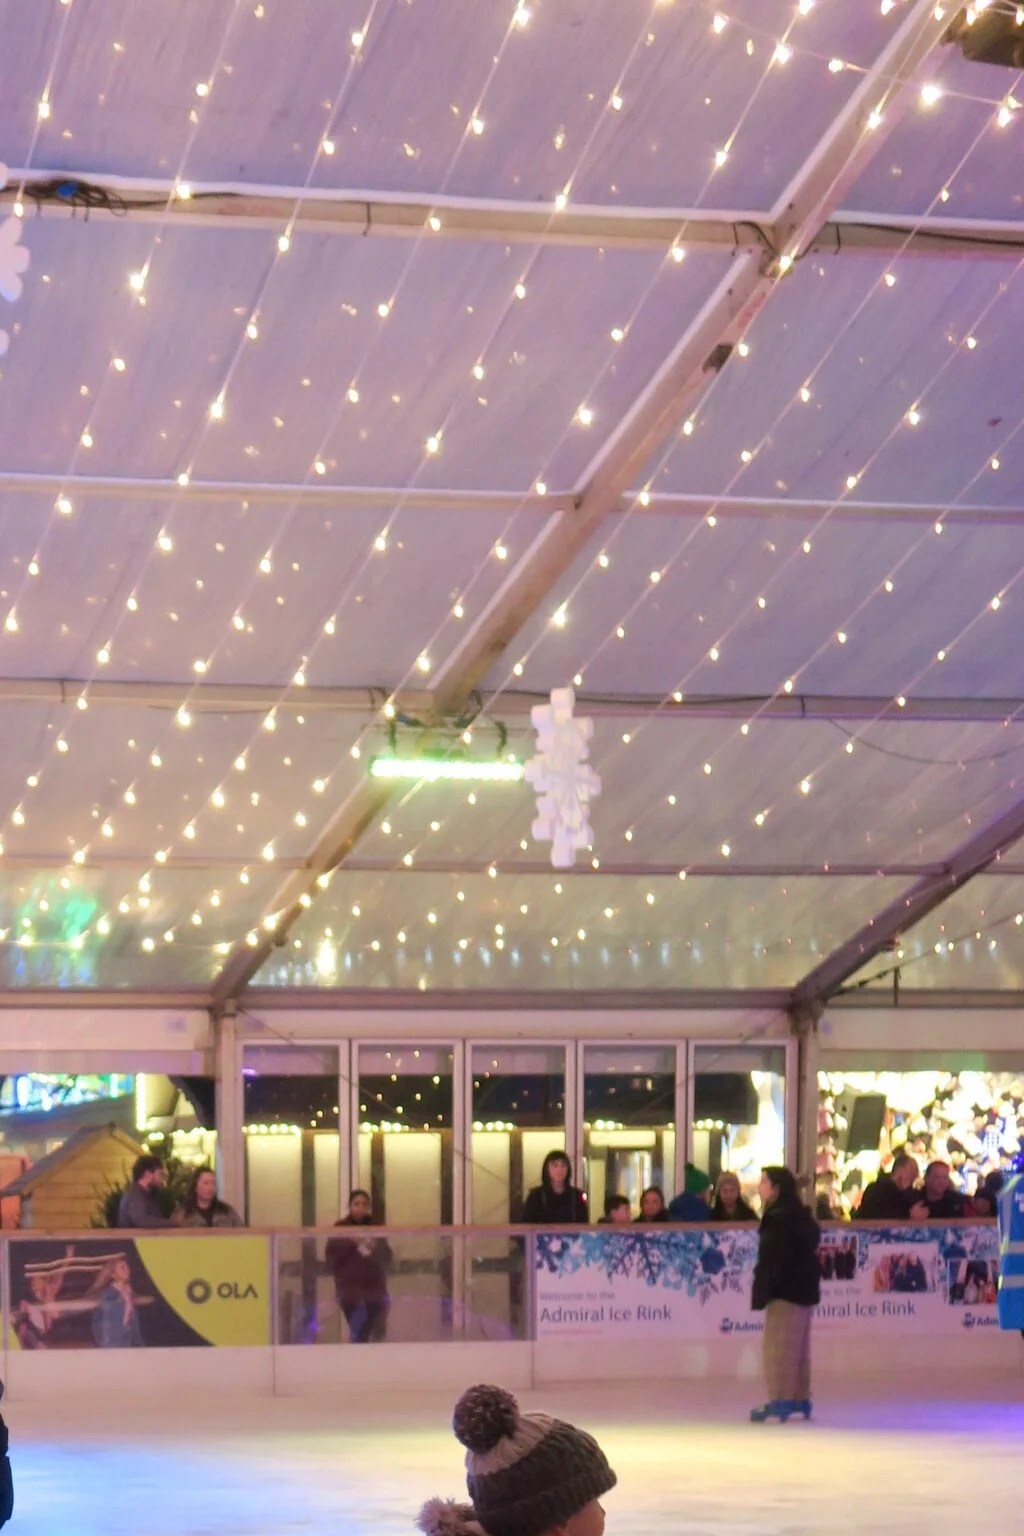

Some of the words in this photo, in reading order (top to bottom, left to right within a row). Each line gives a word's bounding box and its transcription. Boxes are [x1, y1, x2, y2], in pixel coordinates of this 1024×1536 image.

[217, 1281, 259, 1299] OLA
[587, 1290, 598, 1300] to
[599, 1290, 615, 1300] the
[540, 1306, 604, 1322] Admiral
[610, 1307, 632, 1321] Ice
[637, 1304, 673, 1321] Rink
[810, 1303, 851, 1318] miral
[856, 1303, 878, 1317] Ice
[882, 1300, 916, 1316] Rink
